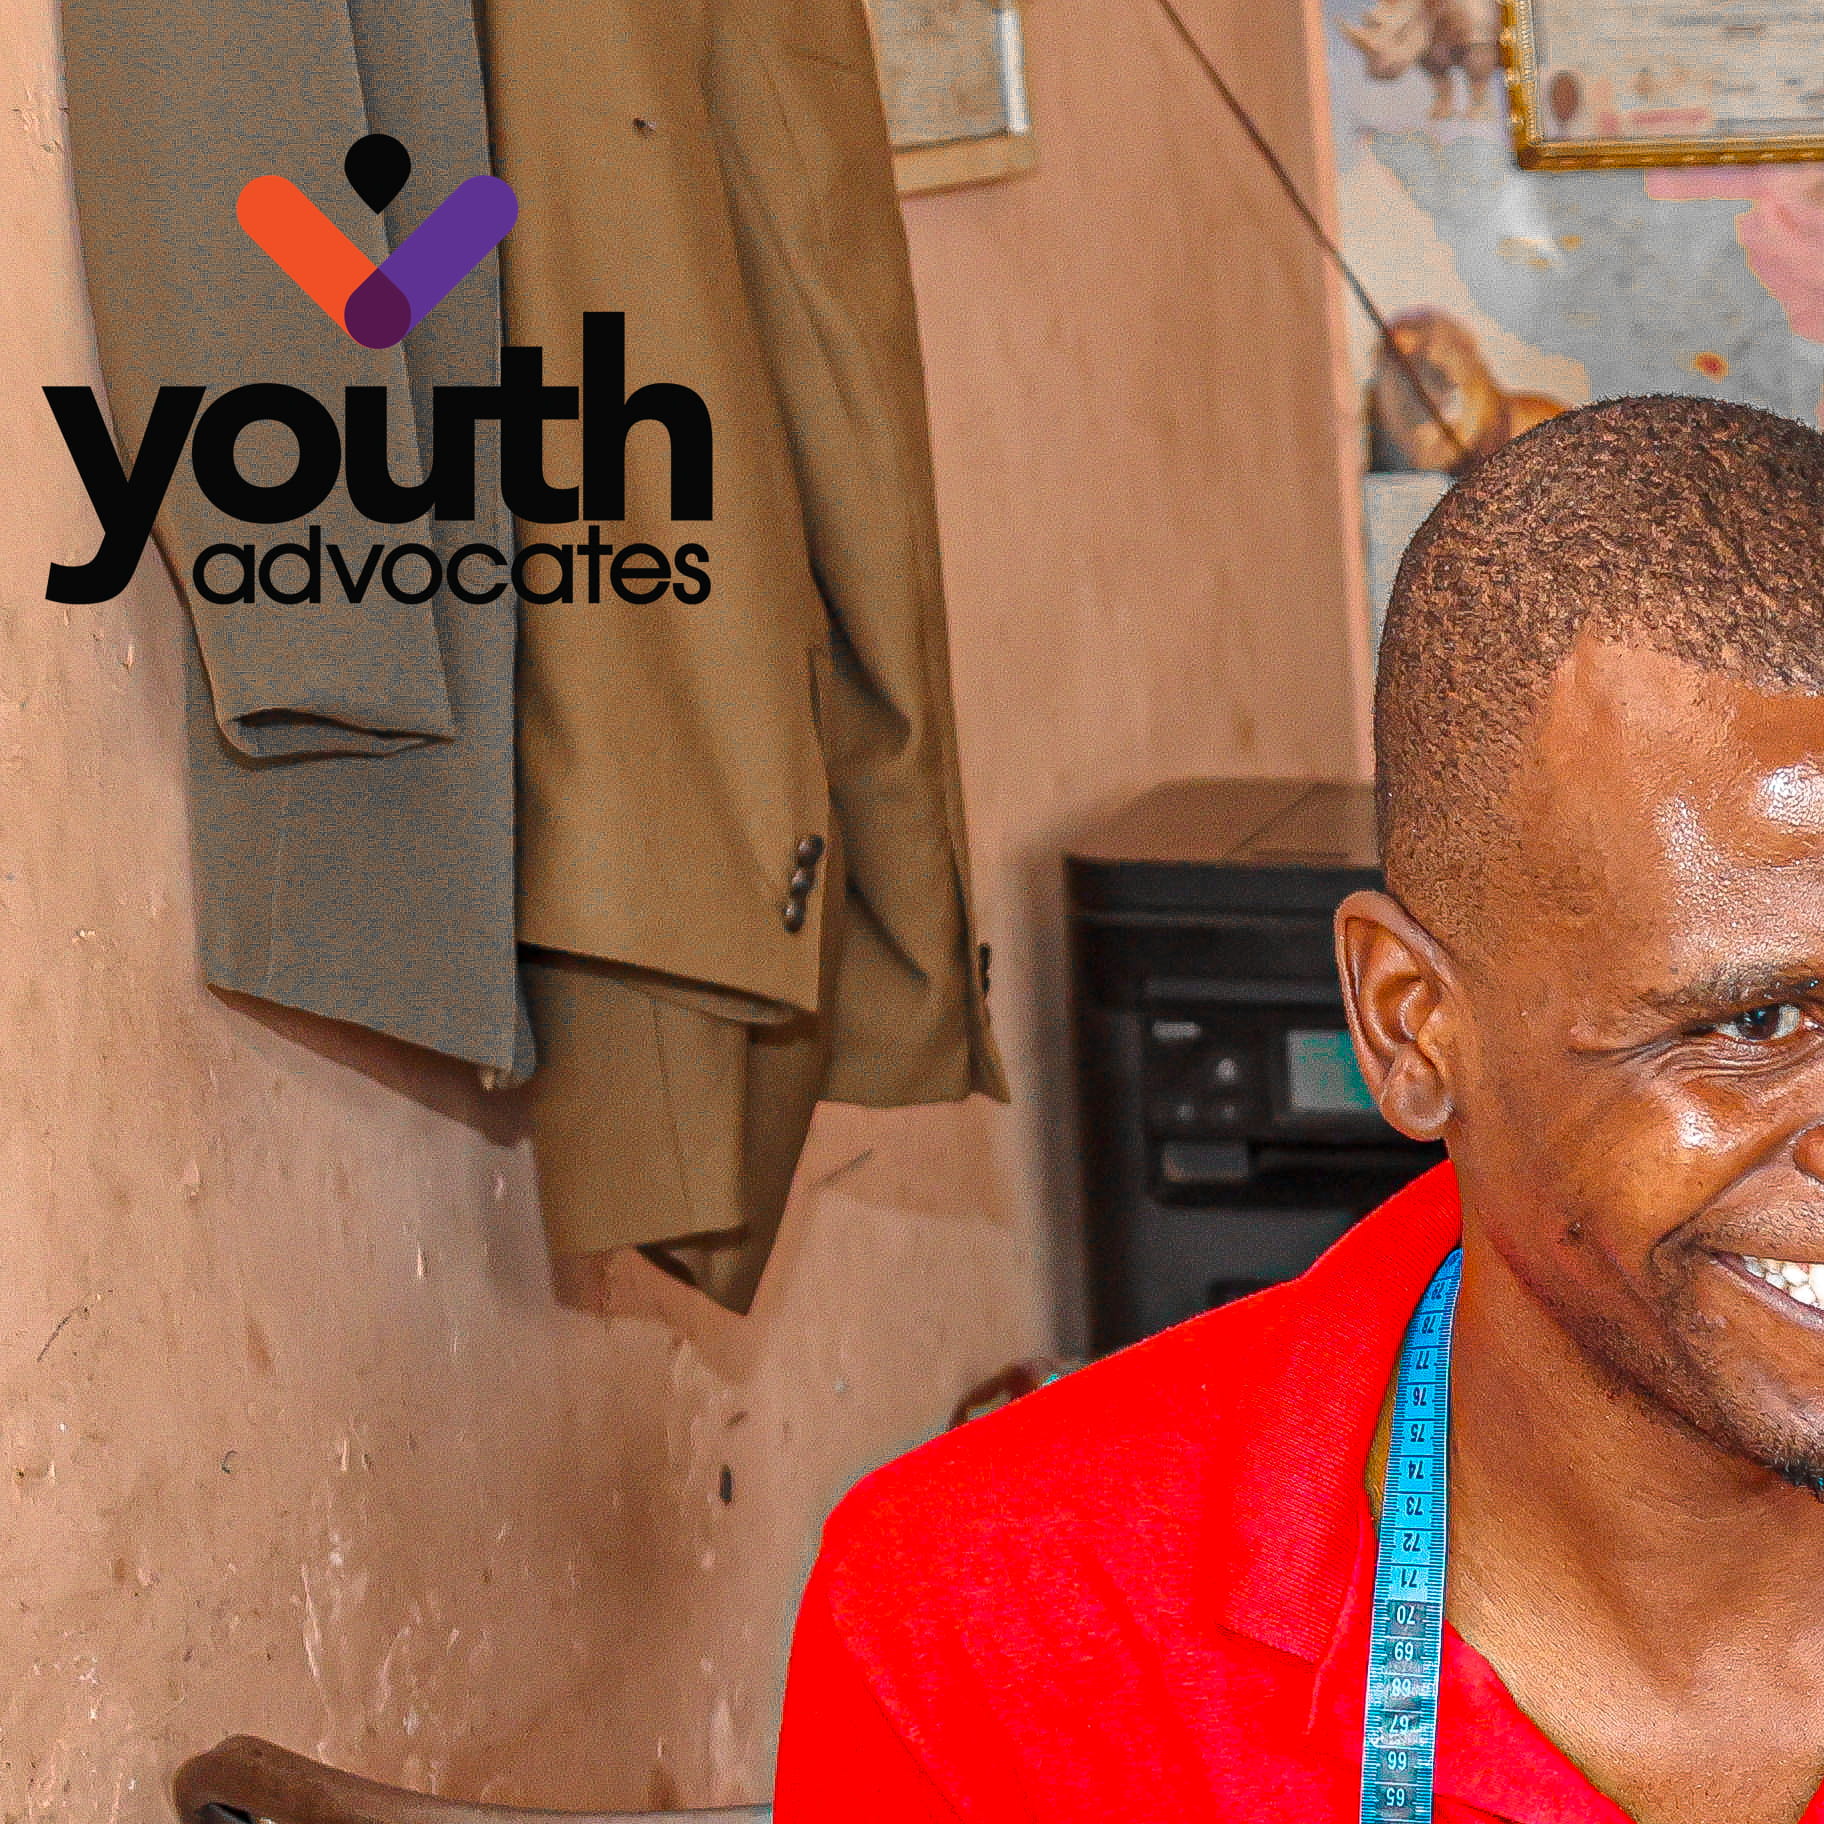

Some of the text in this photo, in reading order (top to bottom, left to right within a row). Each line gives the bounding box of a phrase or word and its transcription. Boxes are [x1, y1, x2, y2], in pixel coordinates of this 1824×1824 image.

[1416, 1350, 1429, 1369] 77
[1412, 1387, 1427, 1406] 76
[1411, 1424, 1425, 1442] 75
[1408, 1459, 1424, 1479] 74
[1406, 1497, 1424, 1514] 73
[1403, 1534, 1422, 1551] 72
[1400, 1569, 1417, 1587] 71
[1397, 1606, 1415, 1624] 70
[1394, 1642, 1413, 1660] 69
[1392, 1679, 1410, 1697] 68
[1390, 1717, 1408, 1733] 67
[1387, 1752, 1406, 1770] 66
[1386, 1788, 1404, 1806] 65
